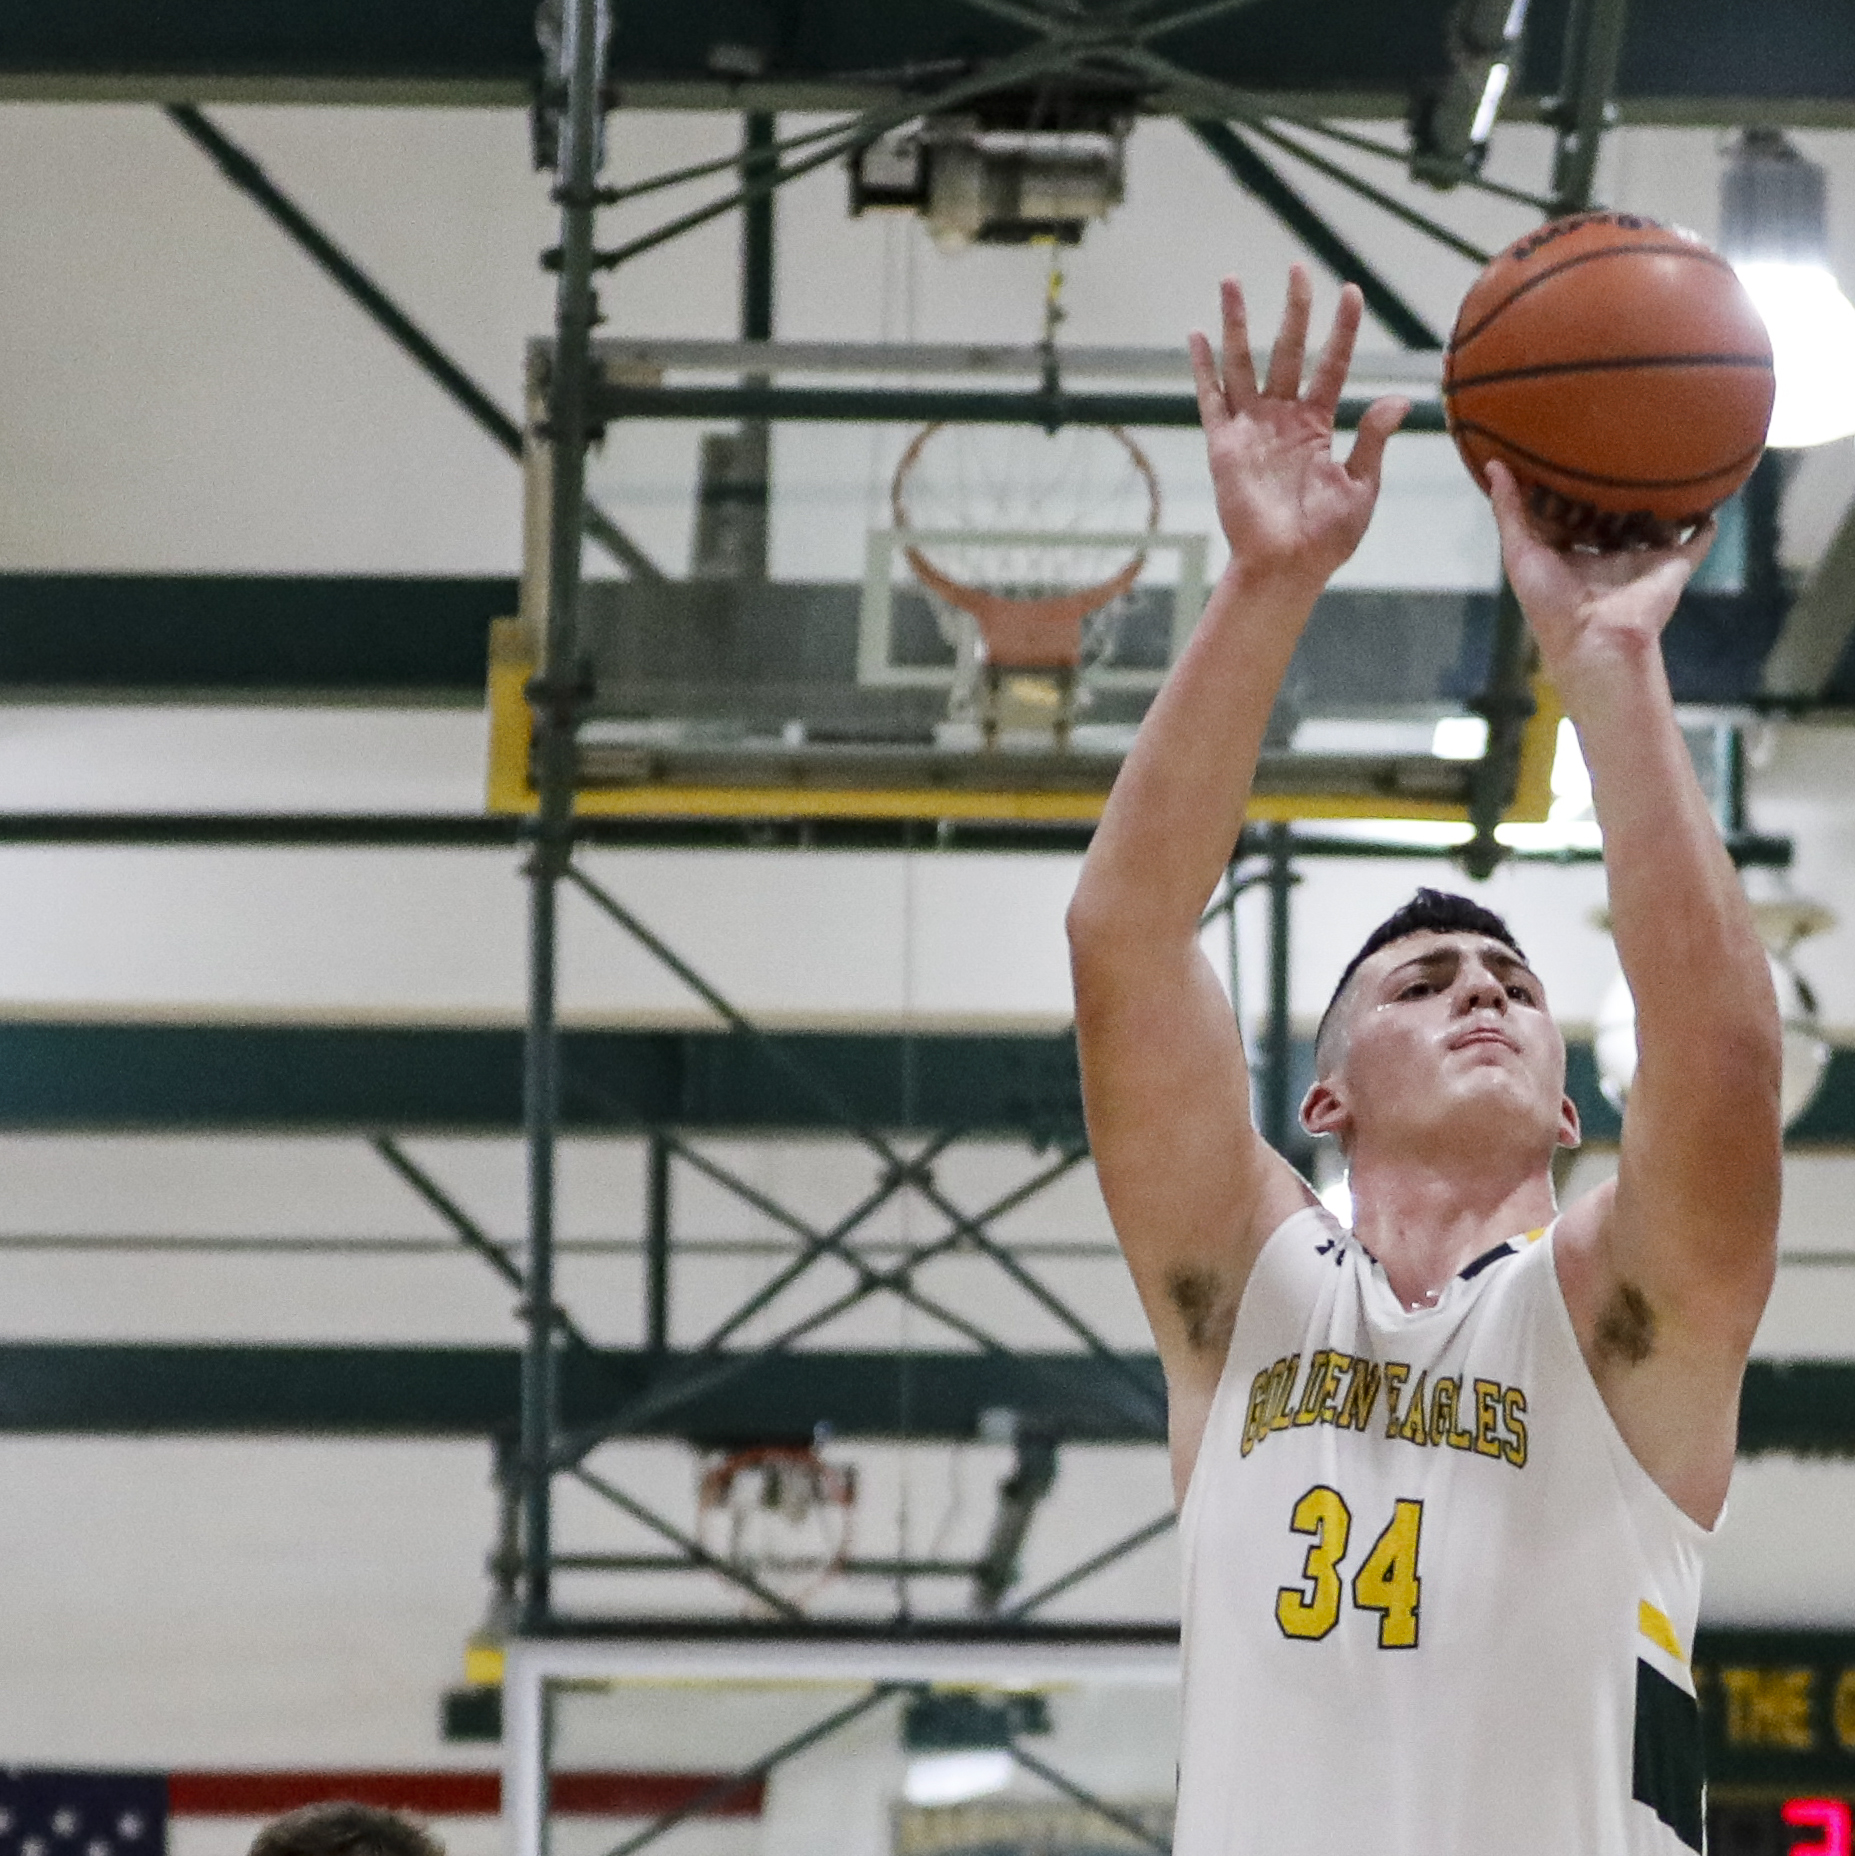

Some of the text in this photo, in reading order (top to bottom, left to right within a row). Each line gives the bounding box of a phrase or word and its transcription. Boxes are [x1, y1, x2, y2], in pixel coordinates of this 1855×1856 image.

[1383, 1361, 1528, 1469] EAGLES
[1275, 1484, 1424, 1650] 34
[1723, 1667, 1814, 1750] THE
